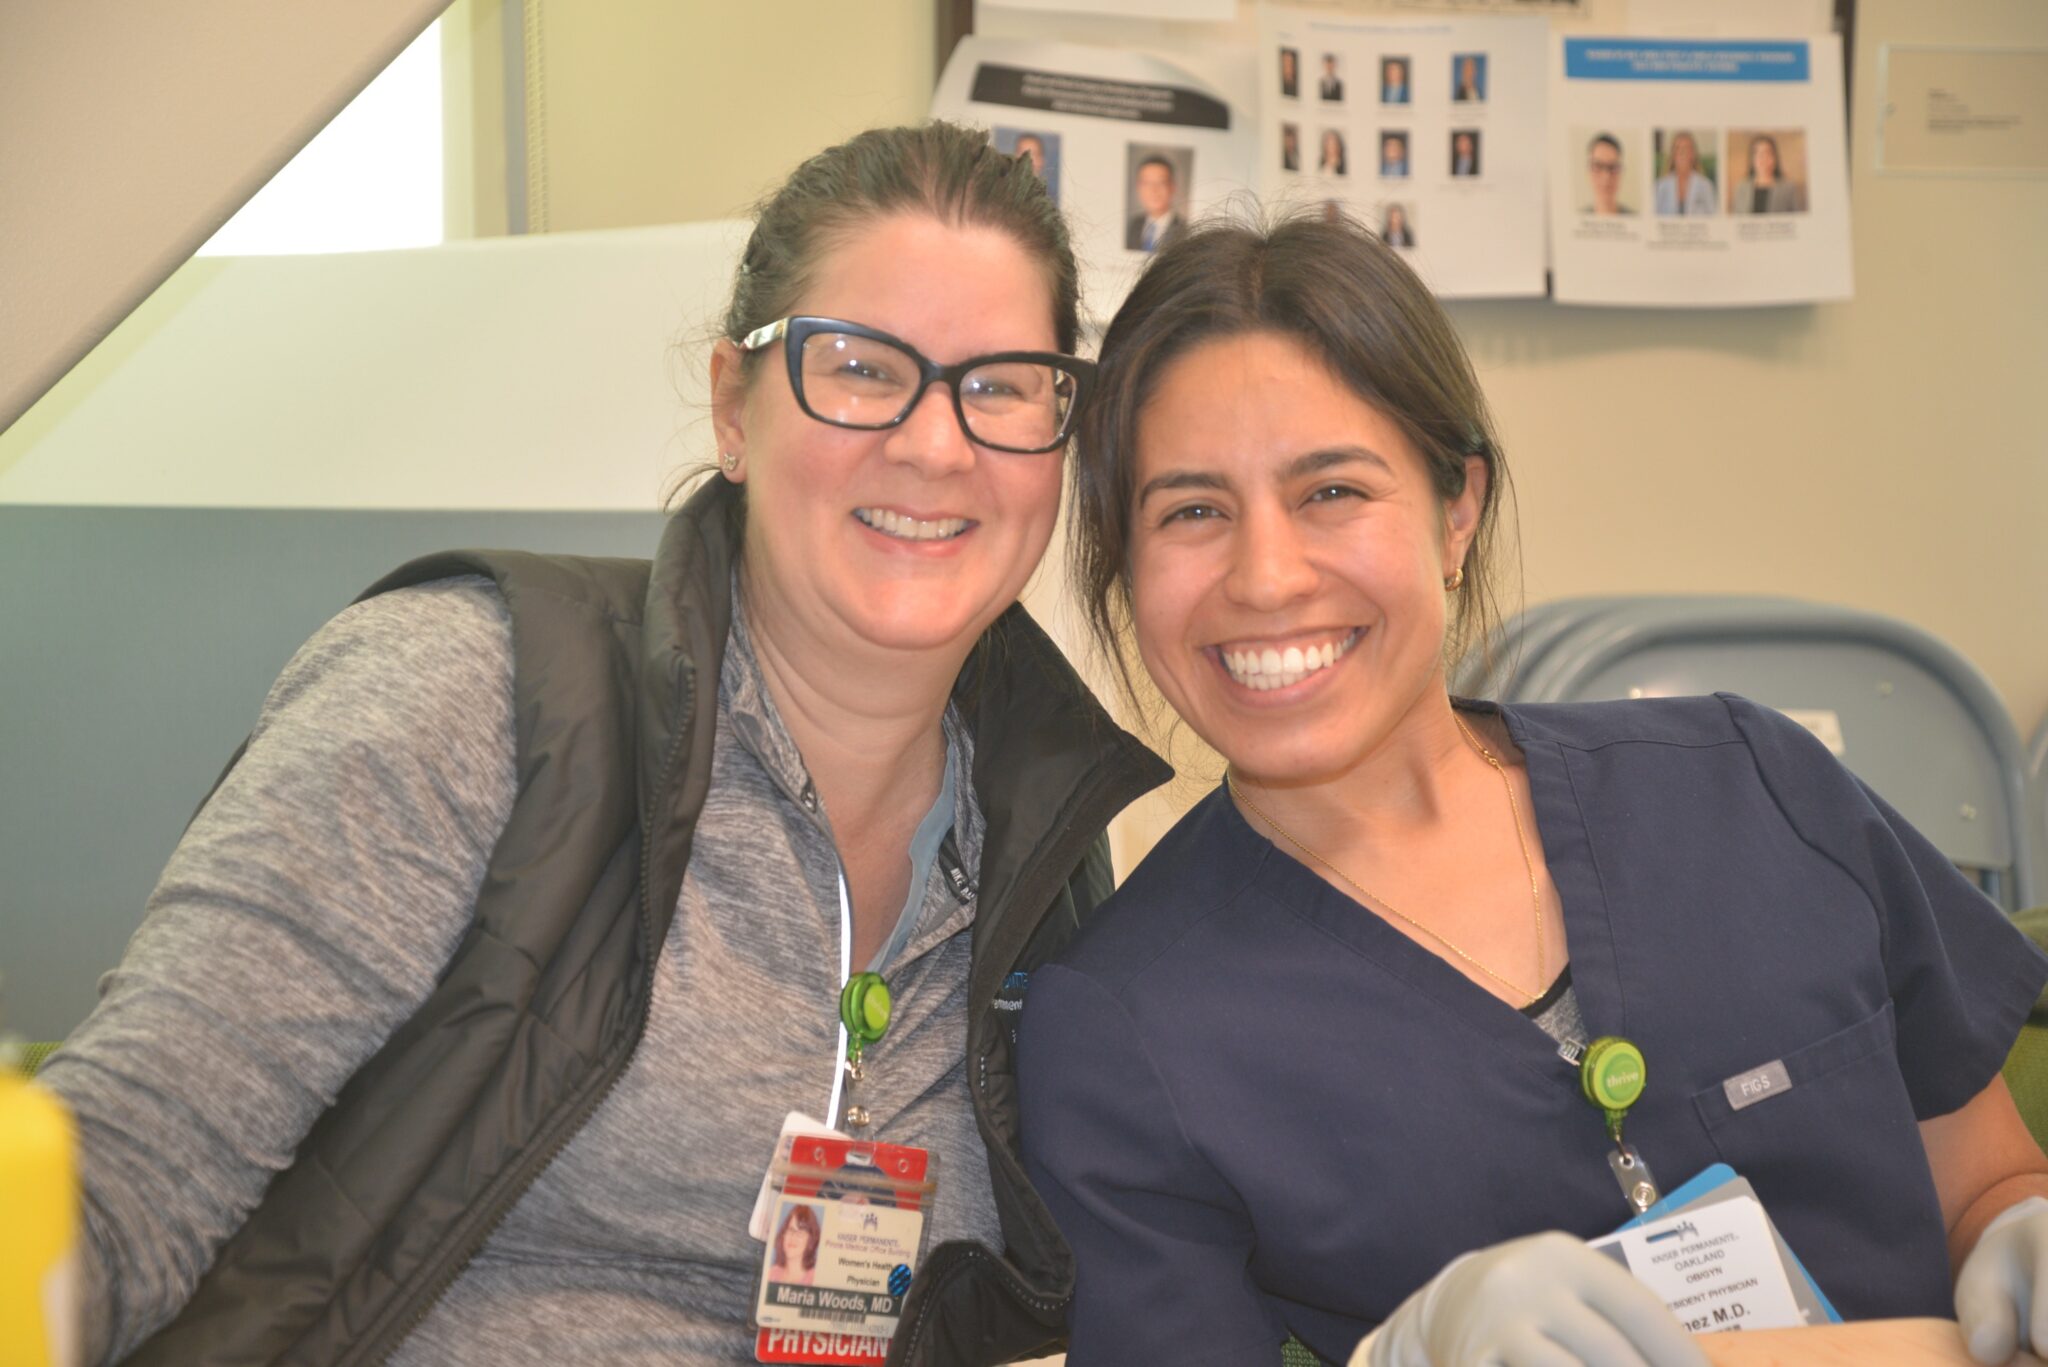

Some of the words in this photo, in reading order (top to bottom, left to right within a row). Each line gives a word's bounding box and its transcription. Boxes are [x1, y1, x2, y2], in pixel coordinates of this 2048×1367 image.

[1606, 1071, 1639, 1088] thrive
[1741, 1074, 1771, 1096] FIGS
[838, 1257, 870, 1269] Women's
[872, 1261, 893, 1271] Health
[1651, 1249, 1679, 1264] KAISER
[1674, 1249, 1725, 1271] OAKLAND
[846, 1275, 880, 1287] Physician
[777, 1286, 815, 1306] Maria
[818, 1290, 868, 1312] Woods,
[870, 1296, 892, 1313] MD
[1666, 1293, 1706, 1312] ESIDENT
[1708, 1277, 1758, 1299] PHYSICIAN
[1712, 1302, 1751, 1325] M.D.
[767, 1328, 888, 1357] PHYSICIAN
